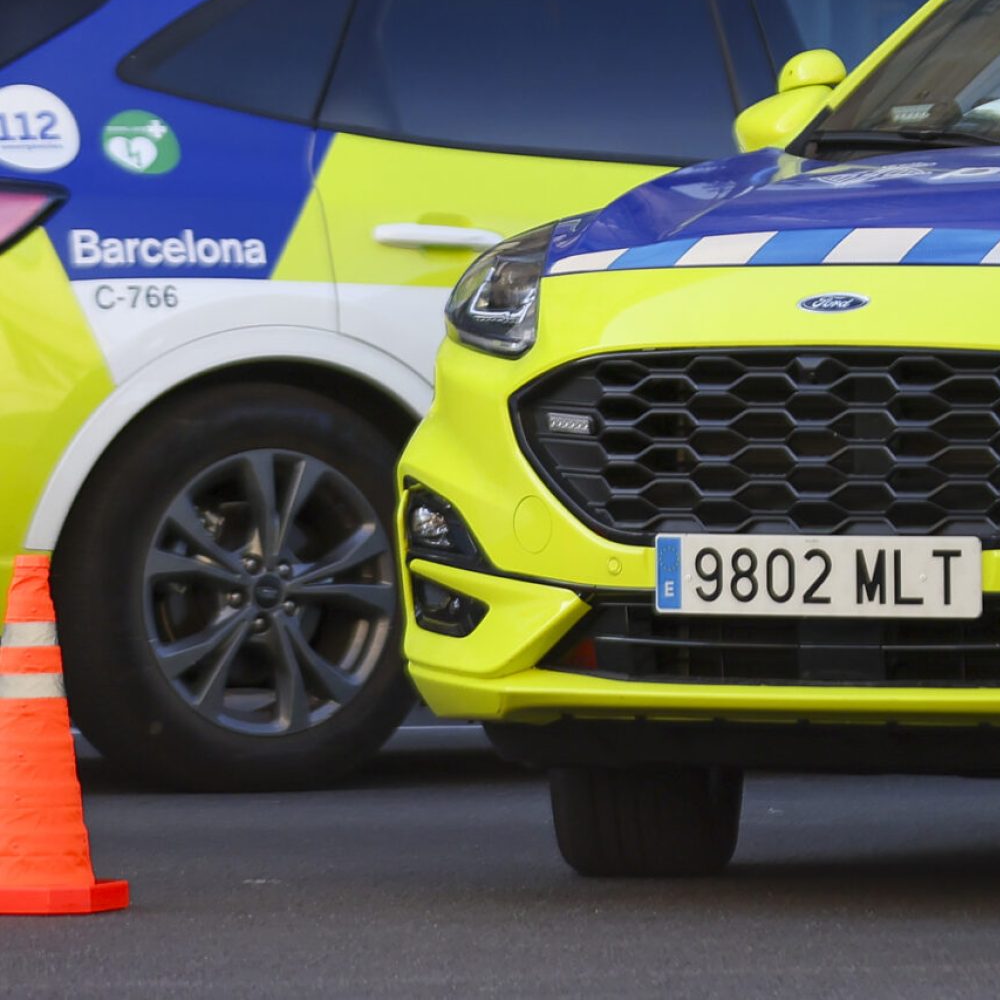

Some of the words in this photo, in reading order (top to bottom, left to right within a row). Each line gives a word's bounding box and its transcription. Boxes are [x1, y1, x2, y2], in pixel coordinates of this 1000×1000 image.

[0, 110, 61, 141] 112
[69, 228, 267, 267] Barcelona
[94, 284, 179, 310] C-766
[812, 296, 855, 309] Ford
[664, 581, 675, 597] E
[695, 547, 832, 603] 9802
[856, 548, 962, 605] MLT
